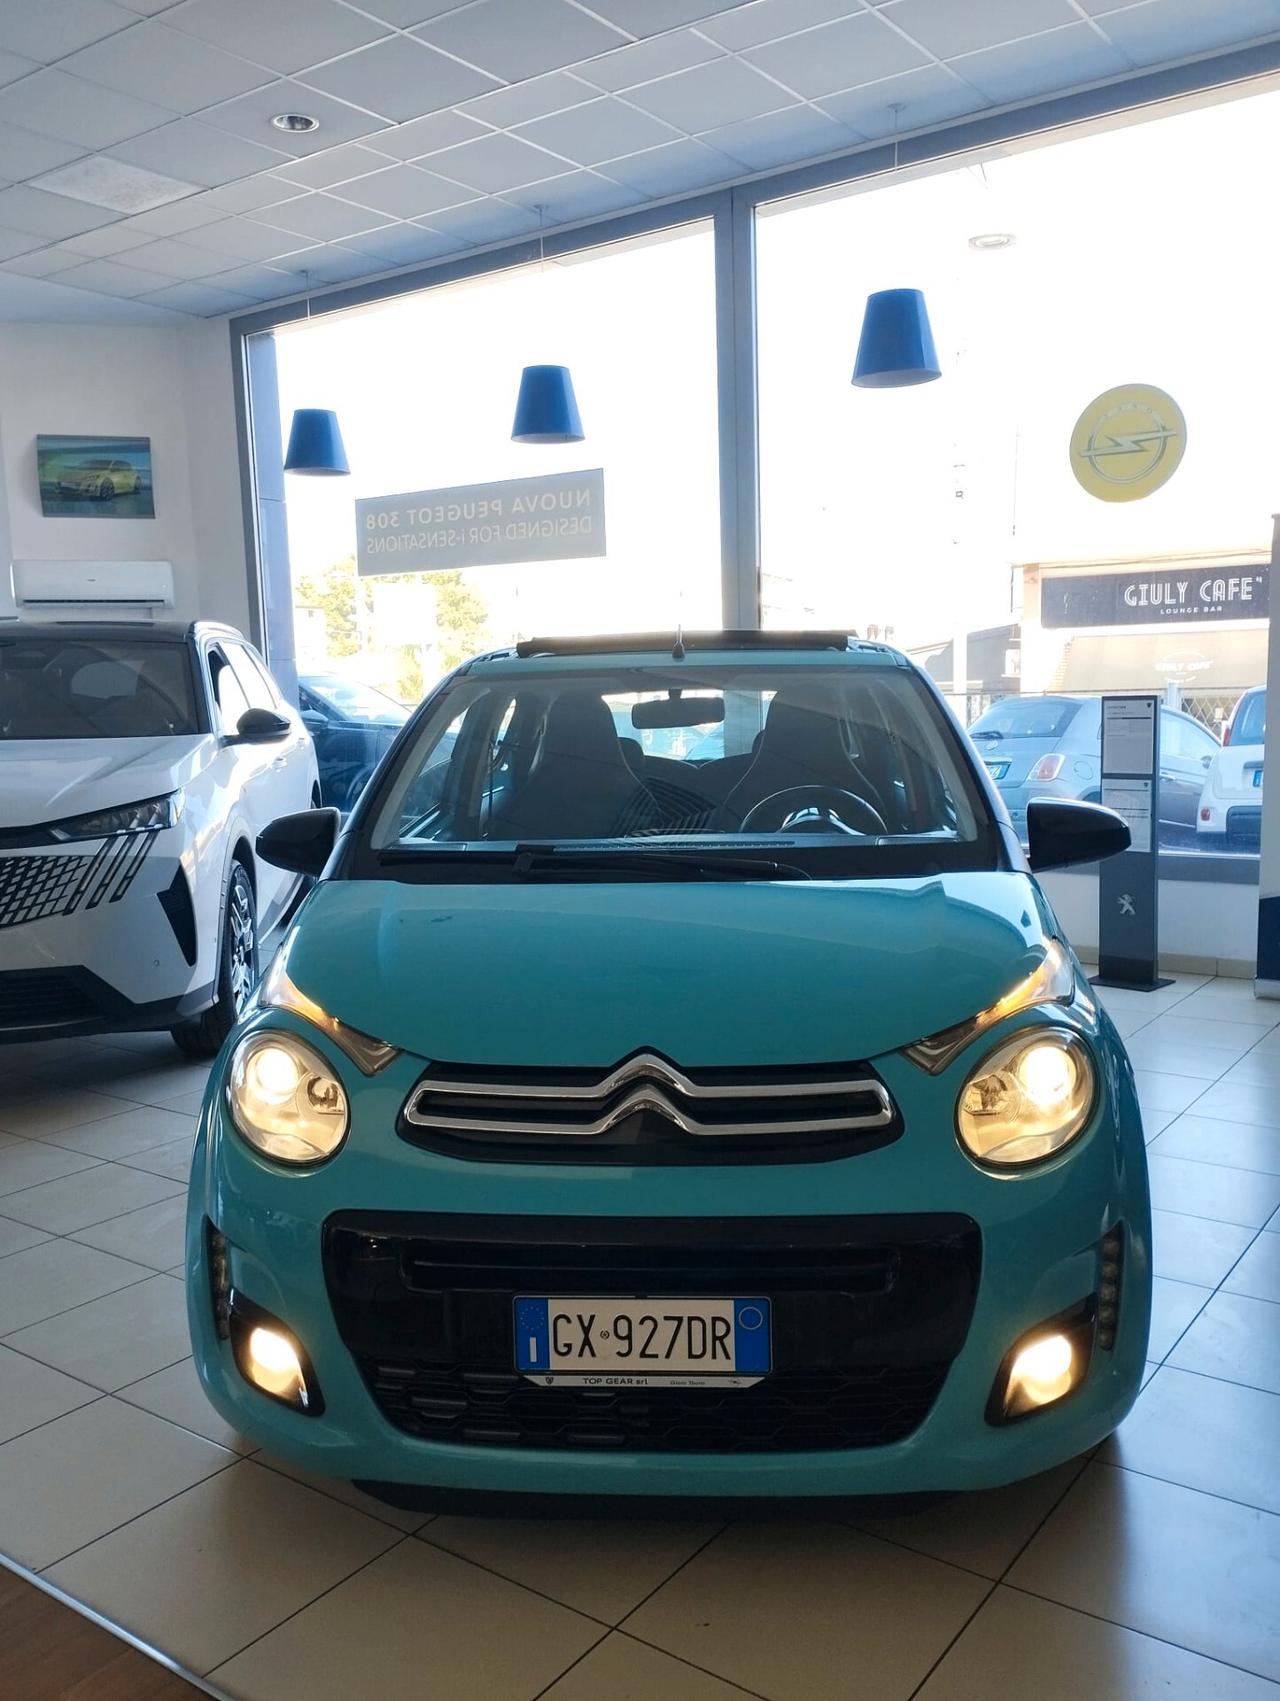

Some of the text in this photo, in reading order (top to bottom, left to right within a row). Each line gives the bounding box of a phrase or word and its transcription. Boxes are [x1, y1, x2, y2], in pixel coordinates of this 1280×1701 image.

[1124, 581, 1188, 607] GIULY
[1160, 605, 1222, 615] LOUNGE BAR
[552, 1313, 731, 1360] GX 927DR
[582, 1377, 649, 1385] TOP GEAR srl
